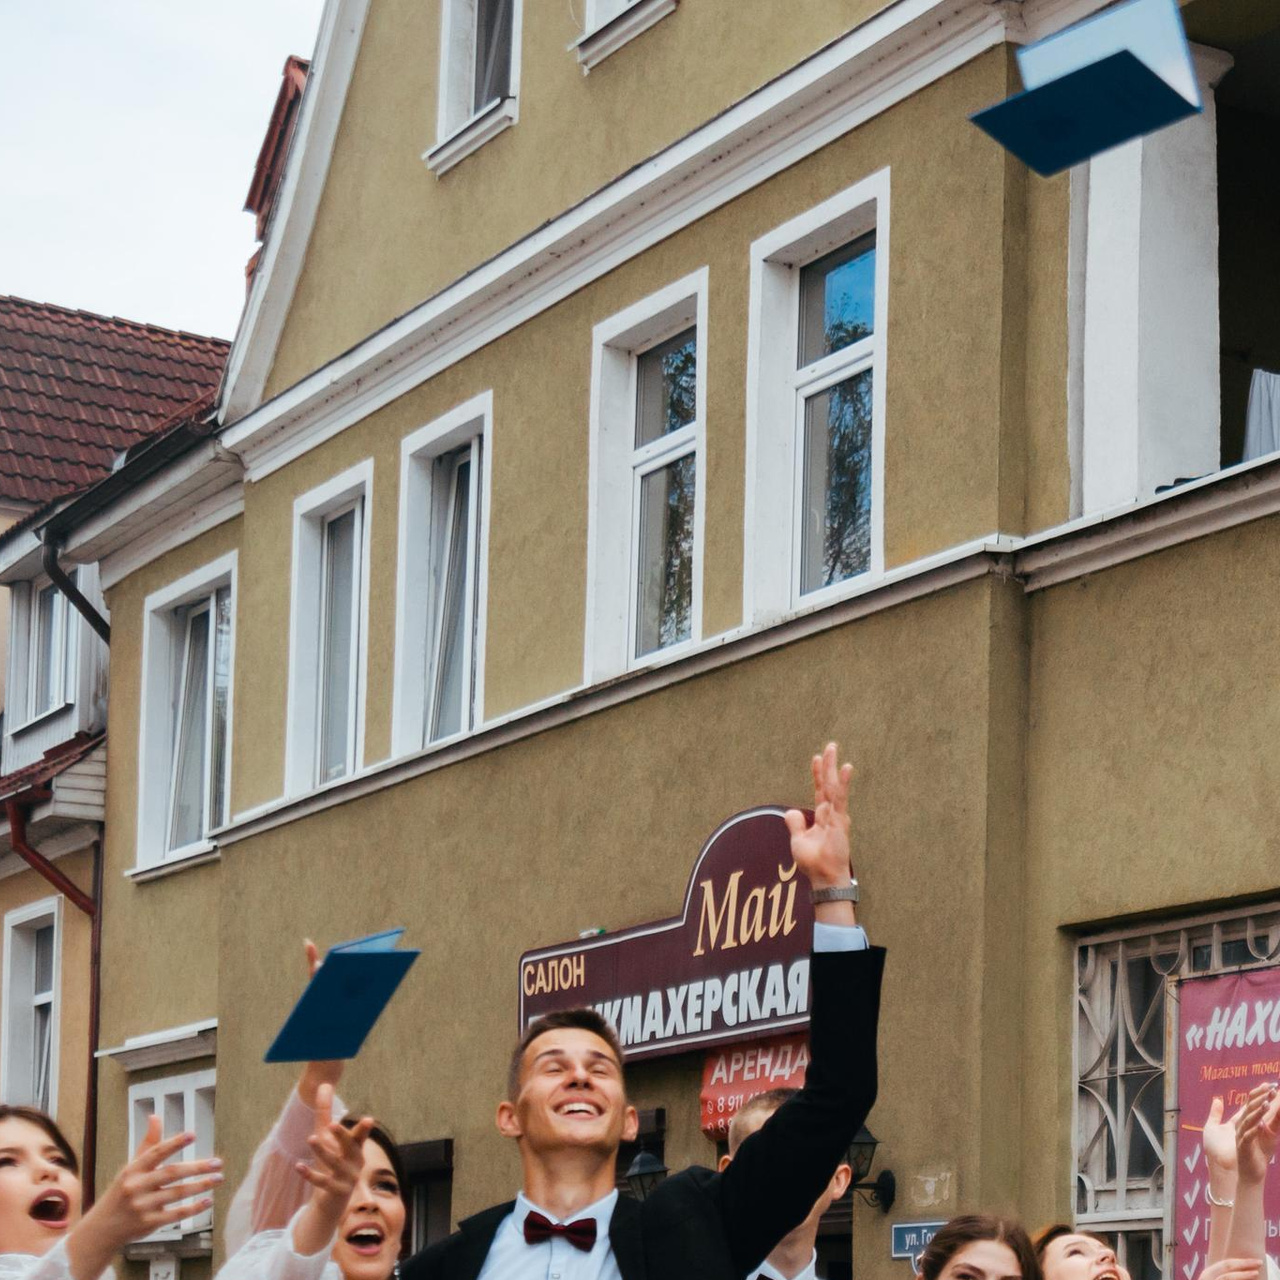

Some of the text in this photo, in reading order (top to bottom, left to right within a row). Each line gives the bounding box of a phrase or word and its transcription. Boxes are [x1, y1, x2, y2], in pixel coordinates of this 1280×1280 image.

[692, 861, 800, 957] Май
[523, 954, 586, 997] САЛОН
[528, 958, 811, 1047] КМАХЕРСКАЯ
[710, 1043, 809, 1086] АРЕНДА
[1199, 1065, 1248, 1082] Магазин
[717, 1096, 725, 1113] 8
[905, 1233, 919, 1250] ул.
